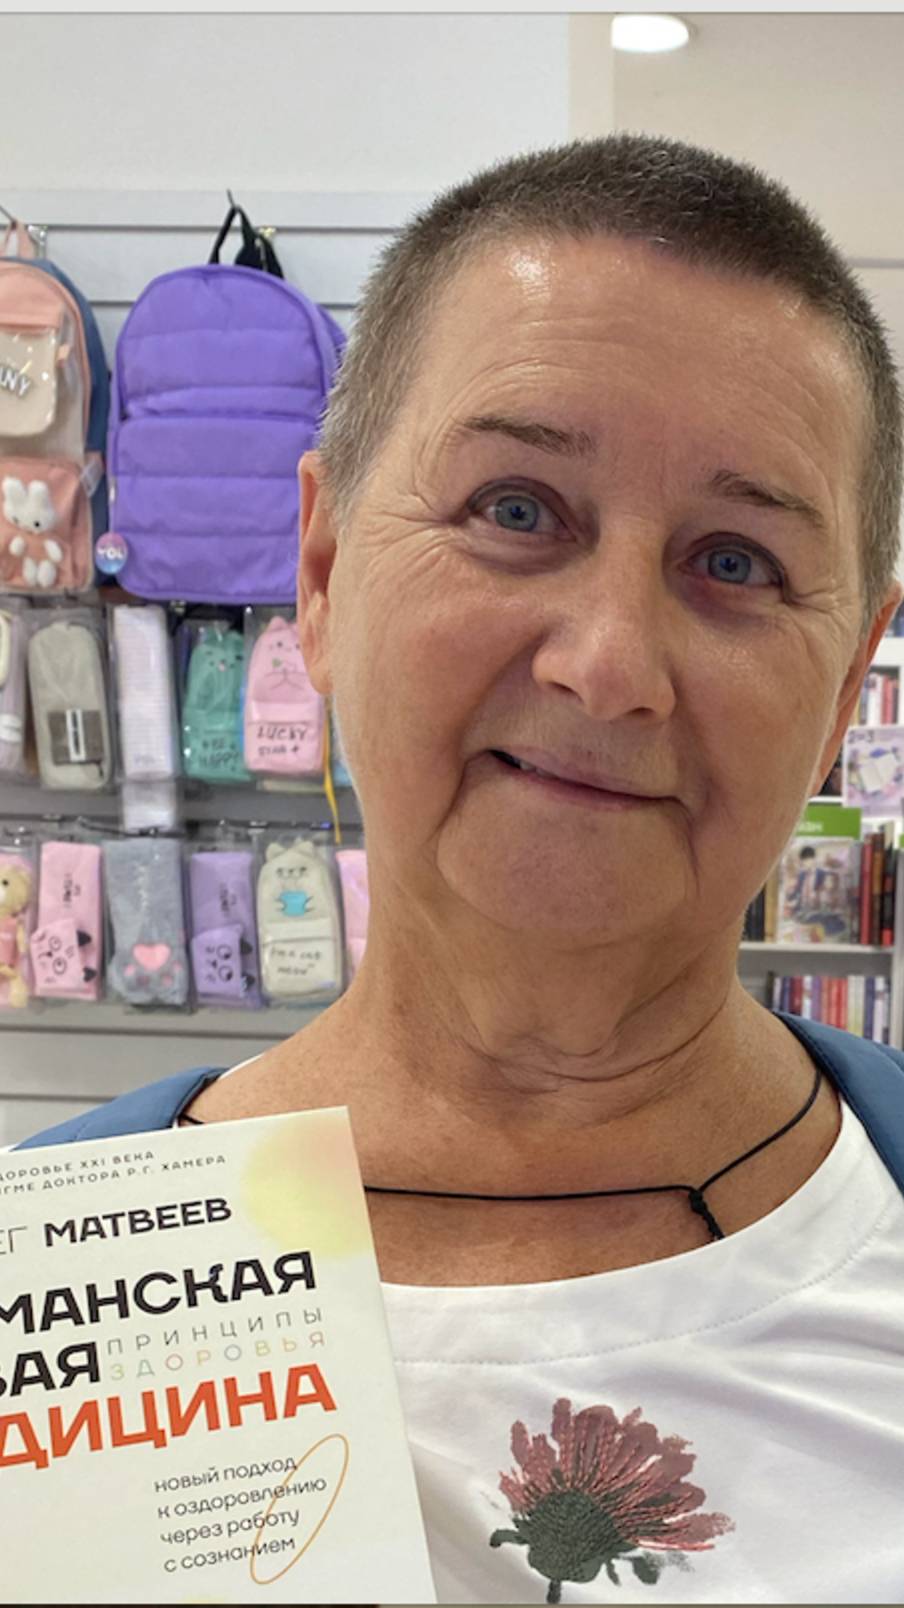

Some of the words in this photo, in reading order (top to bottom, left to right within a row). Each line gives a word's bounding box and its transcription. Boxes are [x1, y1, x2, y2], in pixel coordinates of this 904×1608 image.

[0, 1182, 35, 1195] ГМЕ
[42, 1170, 120, 1190] ДОКТОРА
[161, 1155, 226, 1172] ХАМЕРА
[112, 1151, 154, 1165] ВЕКА
[44, 1198, 232, 1248] МАТВЕЕВ
[0, 1250, 317, 1335] МАНСКАЯ
[106, 1307, 322, 1356] ПРИНЦИПЫ
[0, 1341, 101, 1397] АЯ
[110, 1331, 326, 1382] ЗДОРОВЬЯ
[0, 1363, 337, 1470] ДИЦИНА
[154, 1466, 220, 1493] новый
[223, 1457, 298, 1481] подход
[157, 1505, 171, 1519] к
[173, 1478, 327, 1517] оздоровлению
[160, 1523, 223, 1546] через
[227, 1509, 301, 1537] работу
[163, 1559, 178, 1573] с
[180, 1537, 296, 1570] сознанием
